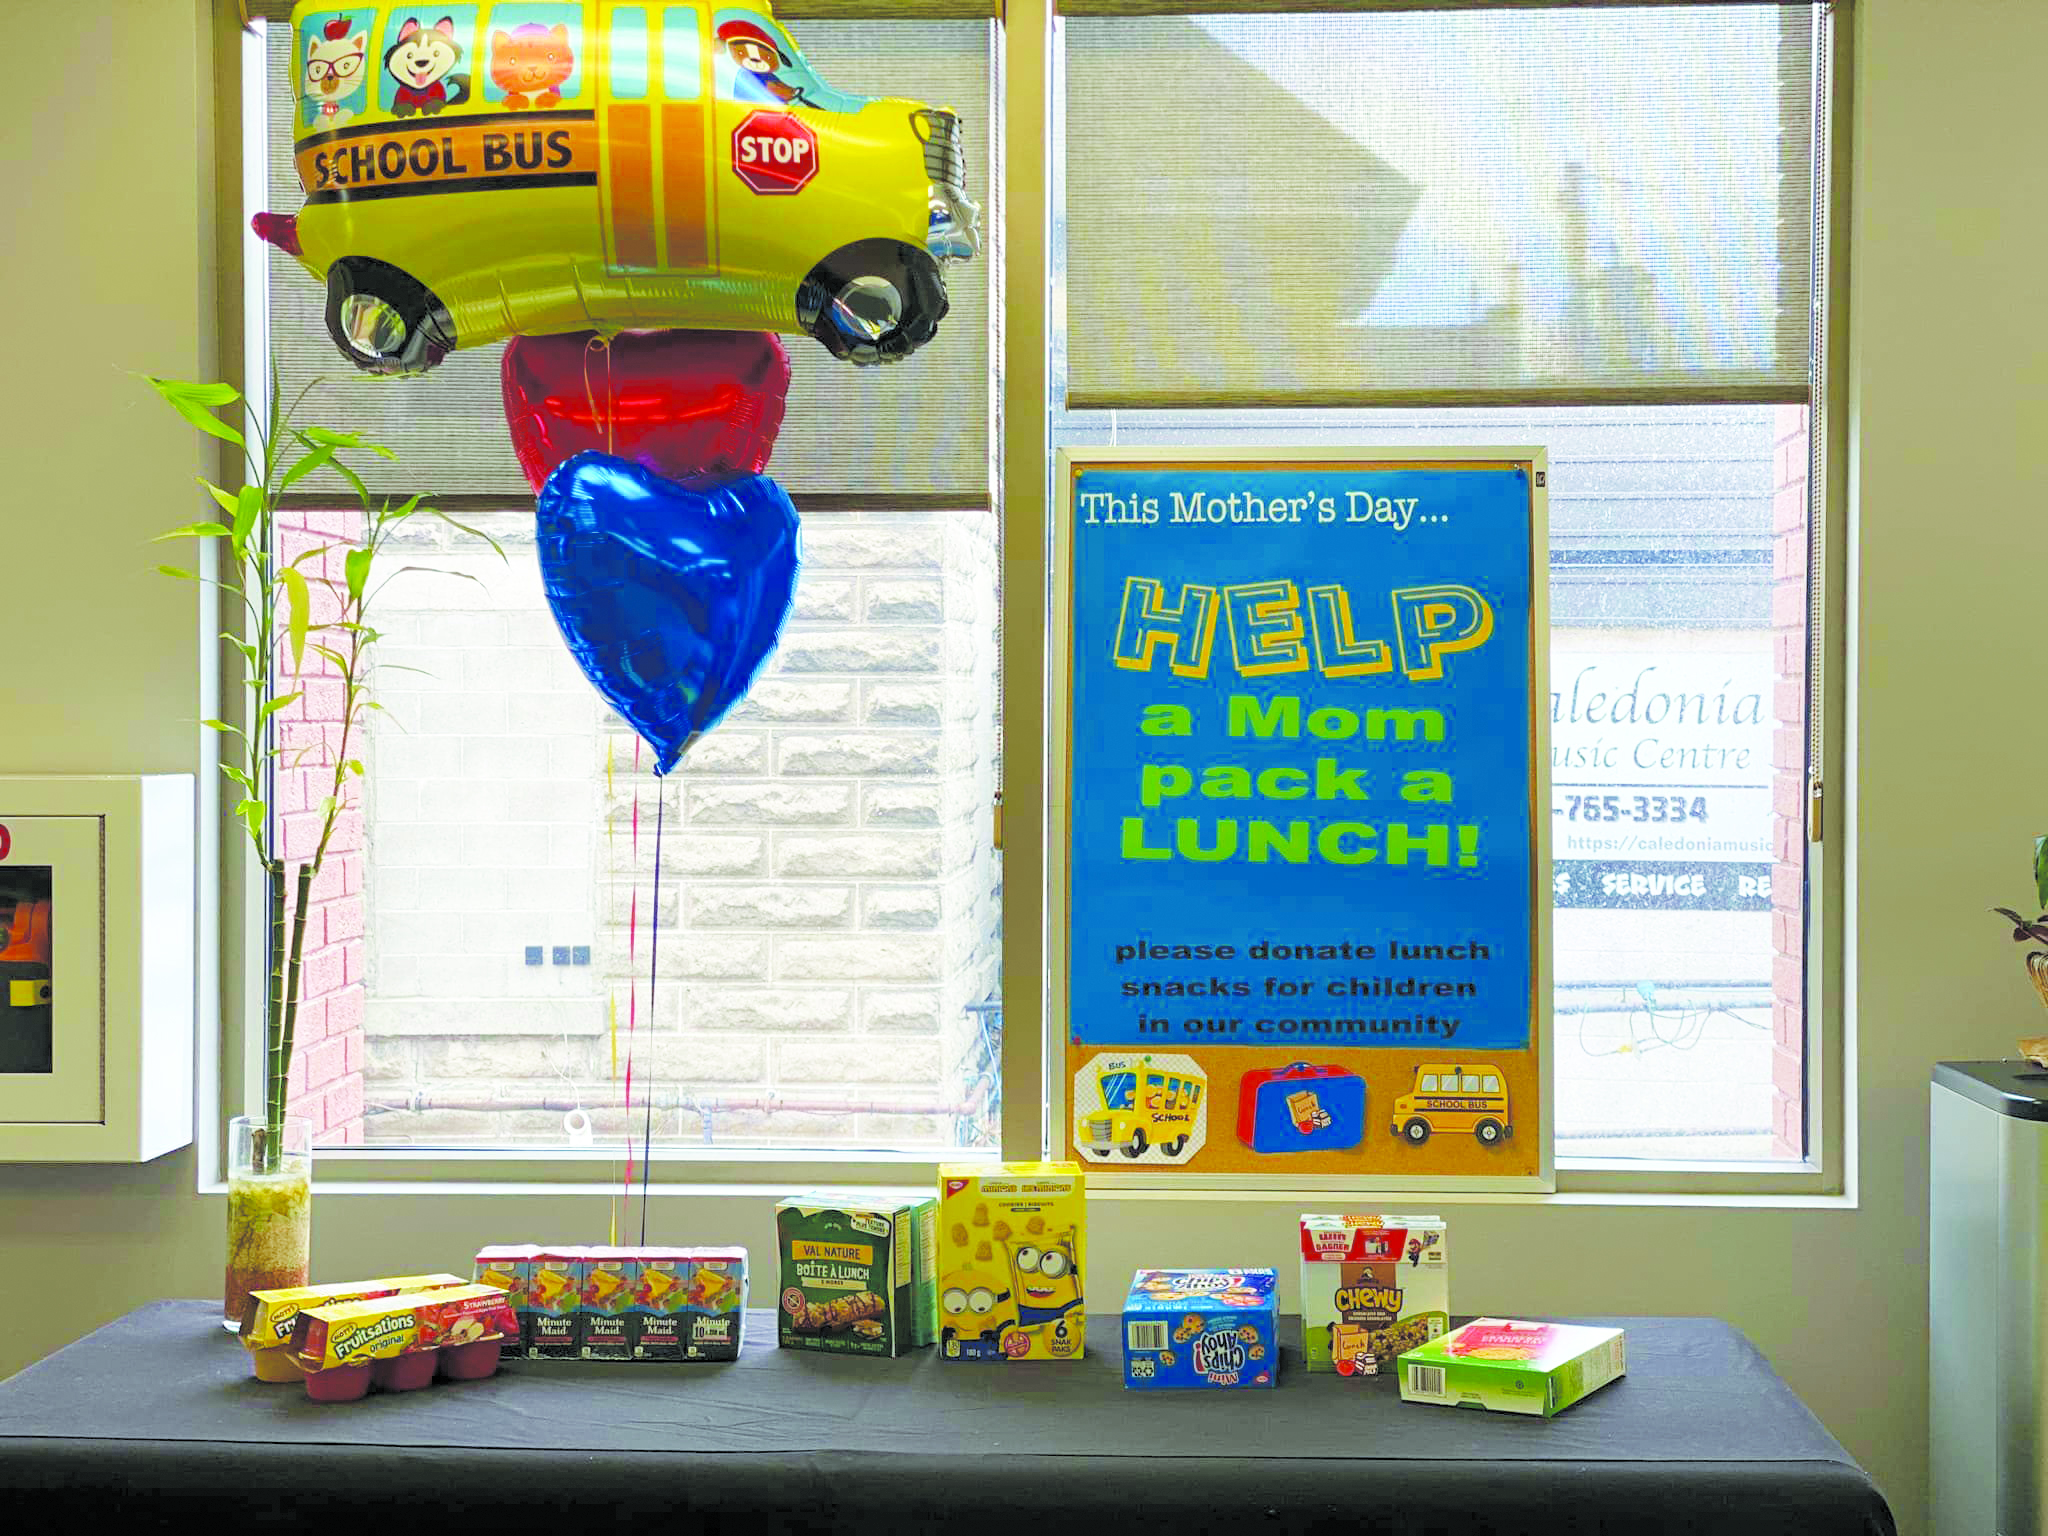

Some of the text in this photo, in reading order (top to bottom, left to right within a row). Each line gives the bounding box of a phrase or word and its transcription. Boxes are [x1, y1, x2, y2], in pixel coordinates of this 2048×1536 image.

[315, 131, 572, 185] SCHOOL BUS
[741, 136, 810, 164] STOP
[1081, 492, 1159, 525] This
[1114, 576, 1494, 681] HELP
[1142, 696, 1445, 741] a Mom
[1633, 738, 1750, 769] Centre
[1142, 759, 1453, 806] pack a
[1121, 818, 1479, 866] LUNCH!
[1601, 872, 1707, 898] SERVICE
[1115, 941, 1490, 964] please donate lunch
[1121, 977, 1477, 998] snacks for children
[1138, 1014, 1461, 1039] in our community
[1108, 1060, 1126, 1070] BUS
[1426, 1099, 1489, 1110] SCHOOL BUS
[1151, 1112, 1191, 1124] SCHOOL
[803, 1245, 861, 1260] VAL NATURE
[796, 1261, 828, 1277] BOÎTE
[838, 1265, 870, 1281] LUNCH
[537, 1316, 572, 1327] Minute
[541, 1326, 568, 1336] Maid
[590, 1316, 625, 1327] Minute
[594, 1326, 621, 1336] Maid
[643, 1316, 678, 1327] Minute
[648, 1326, 675, 1336] Maid
[1055, 1320, 1068, 1338] 6
[334, 1315, 416, 1359] Fruitsations
